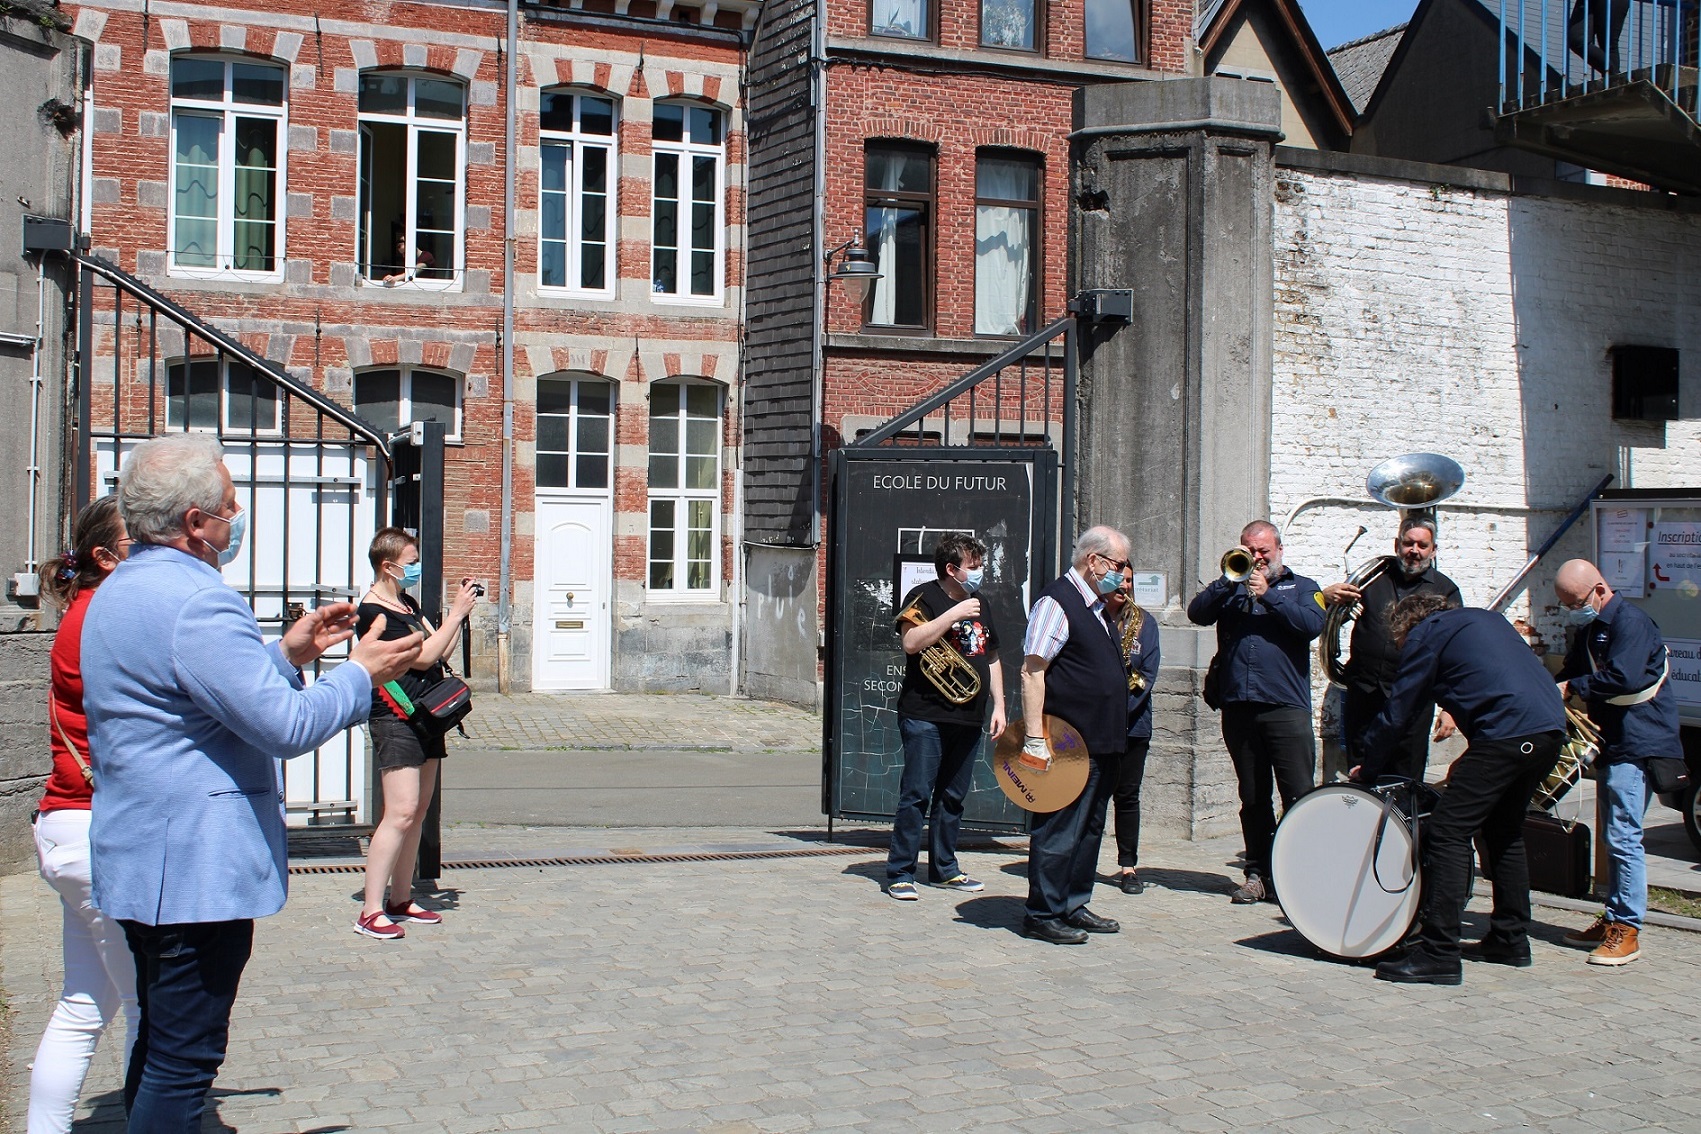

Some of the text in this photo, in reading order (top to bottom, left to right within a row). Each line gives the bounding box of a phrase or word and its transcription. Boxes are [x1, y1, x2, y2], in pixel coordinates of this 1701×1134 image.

[873, 474, 1007, 491] ECOLE DU FUTUR
[1002, 760, 1028, 794] MEINL
